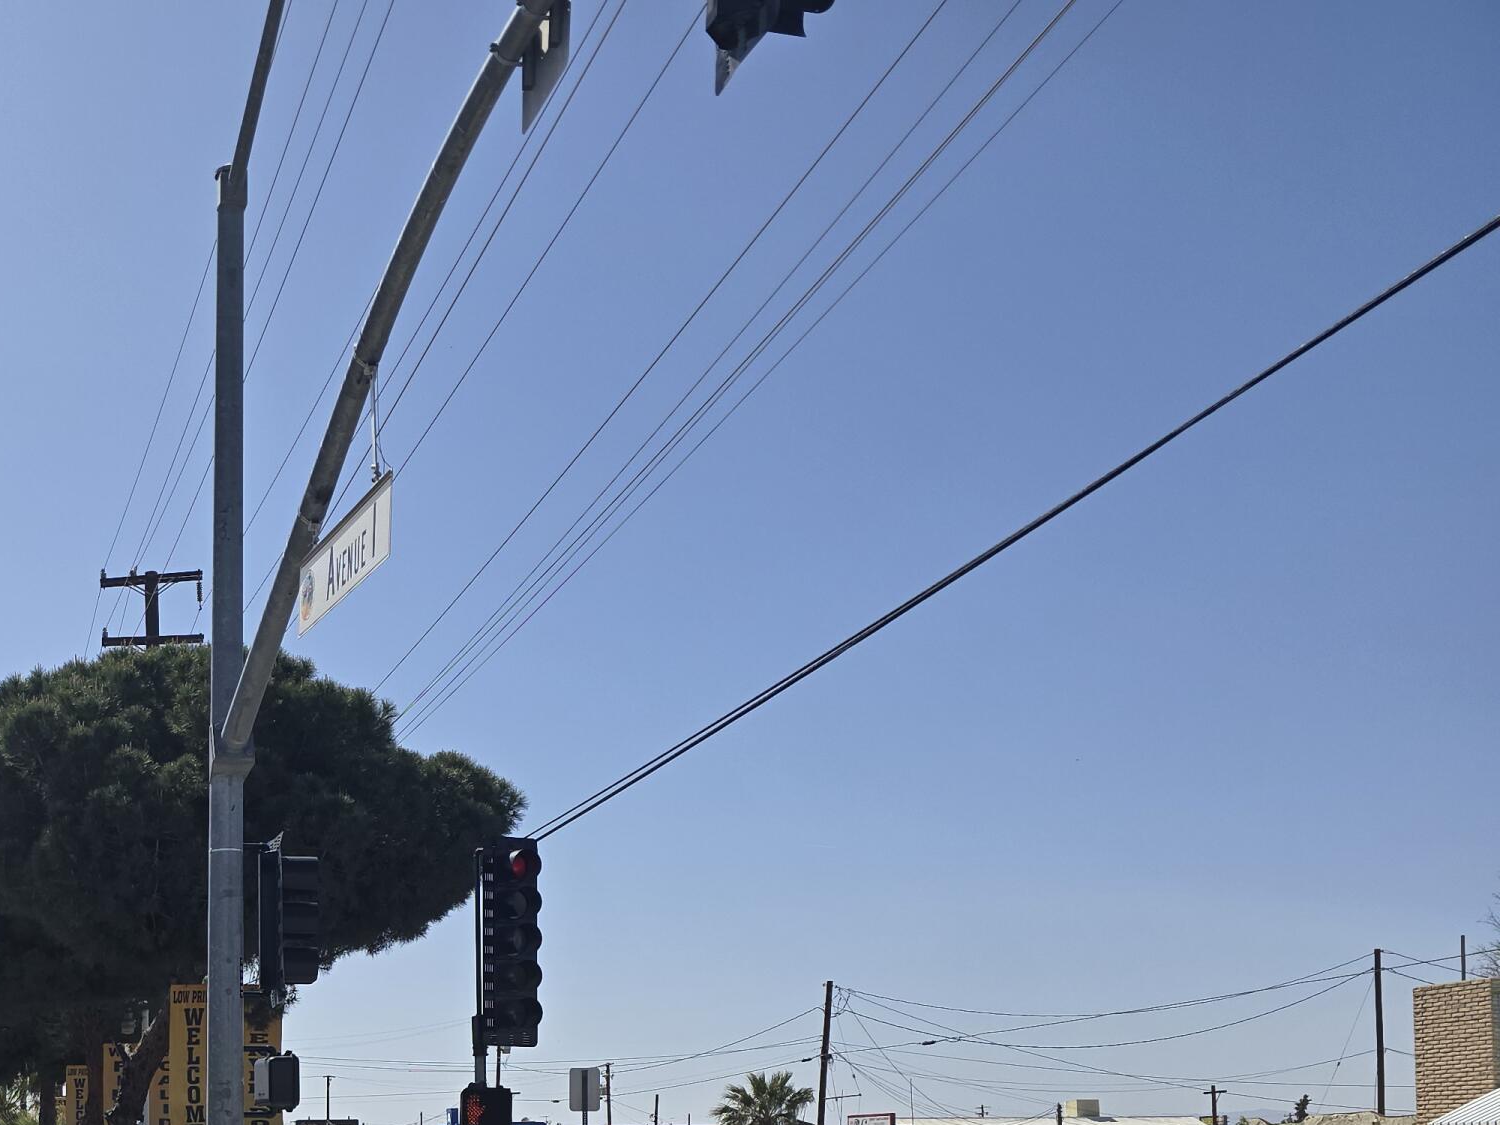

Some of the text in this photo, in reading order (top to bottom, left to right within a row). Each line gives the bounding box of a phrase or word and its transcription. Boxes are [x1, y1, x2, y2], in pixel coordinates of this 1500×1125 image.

[327, 502, 377, 601] AVENUE I
[173, 991, 189, 1004] LOW
